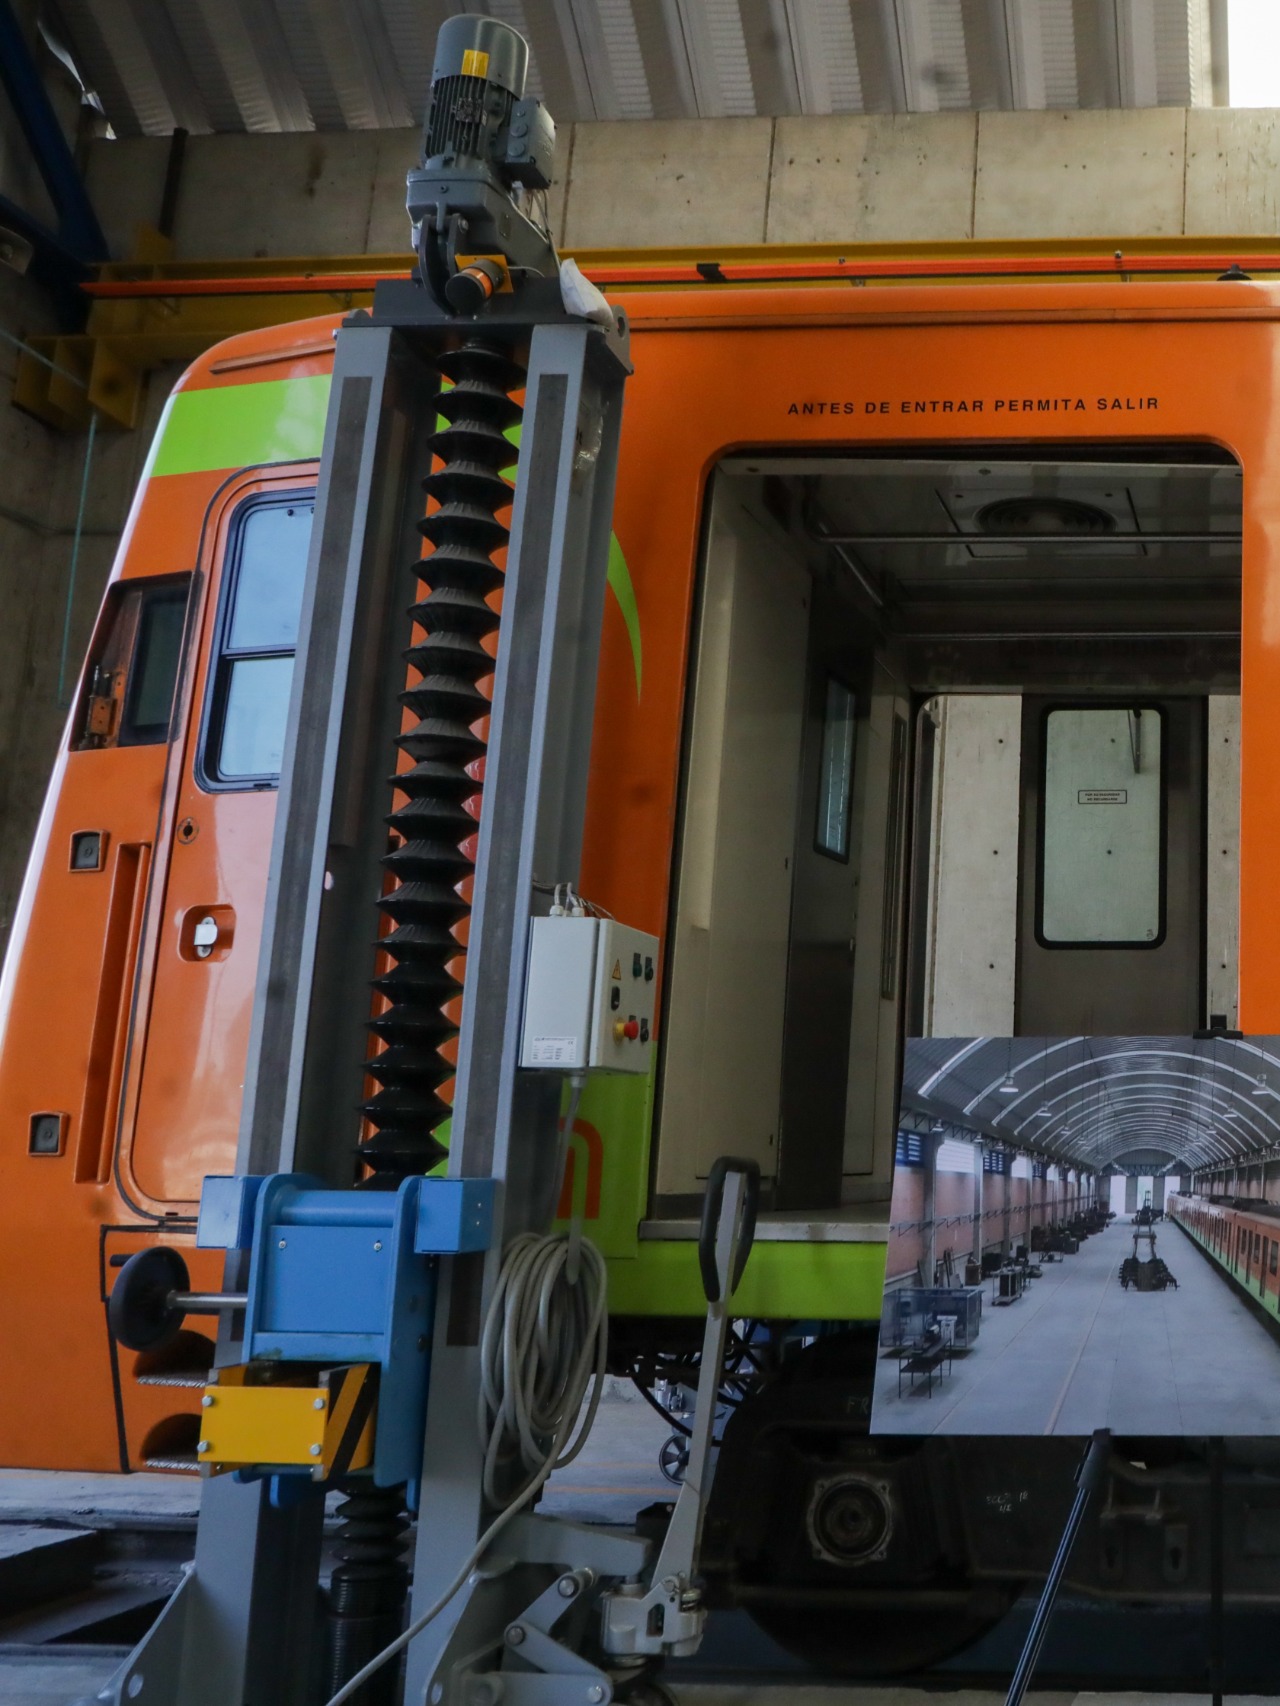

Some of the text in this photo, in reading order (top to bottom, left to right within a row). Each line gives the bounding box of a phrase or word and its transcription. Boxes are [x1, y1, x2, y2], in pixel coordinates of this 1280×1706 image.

[787, 397, 1158, 415] ANTES DE ENTRAR PERMITA SALIR
